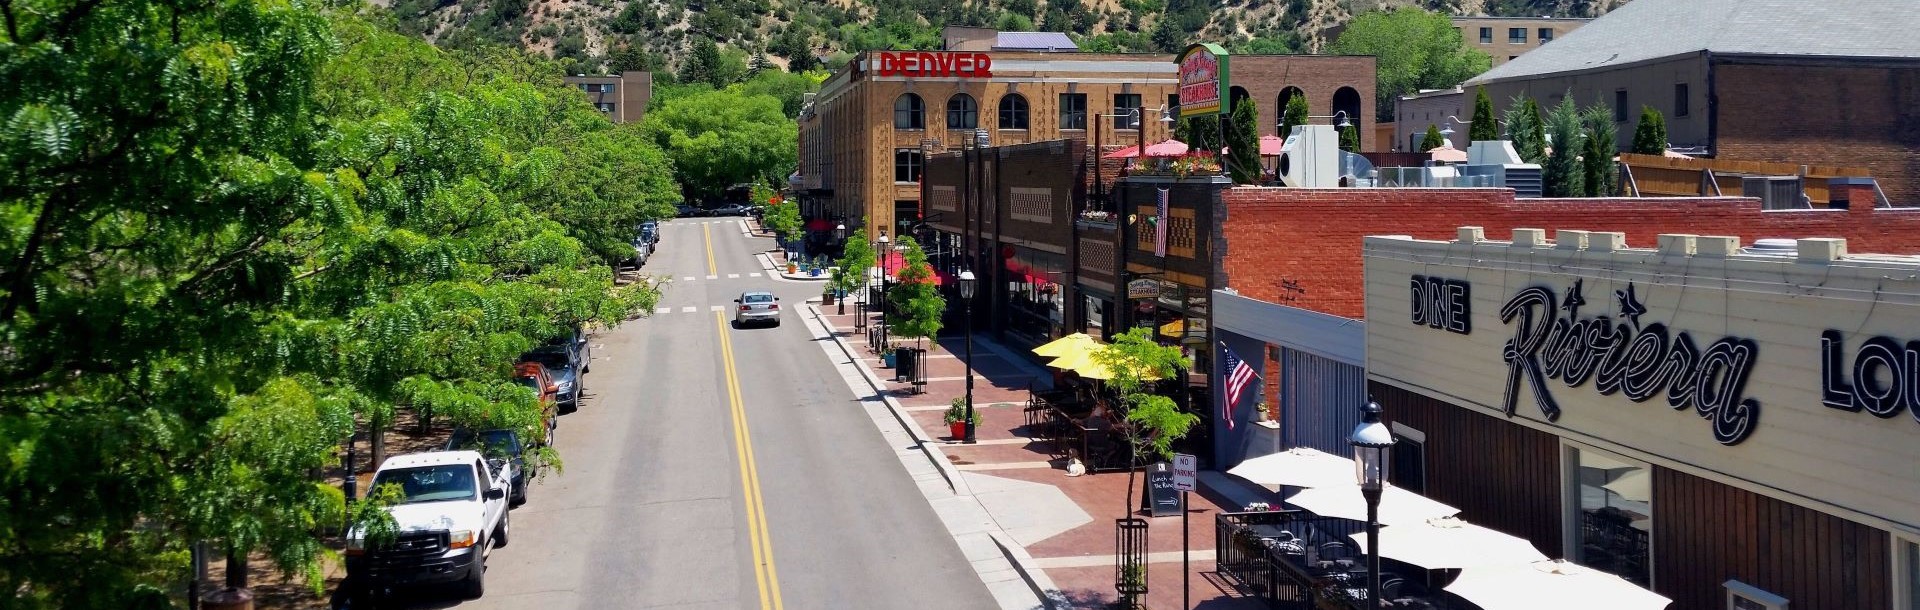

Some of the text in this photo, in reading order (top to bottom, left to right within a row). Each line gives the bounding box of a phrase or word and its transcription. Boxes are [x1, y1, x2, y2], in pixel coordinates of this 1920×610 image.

[880, 52, 993, 77] DENVER
[1411, 275, 1471, 335] DINE
[1500, 278, 1760, 446] Riviera
[1174, 469, 1195, 477] PARKING
